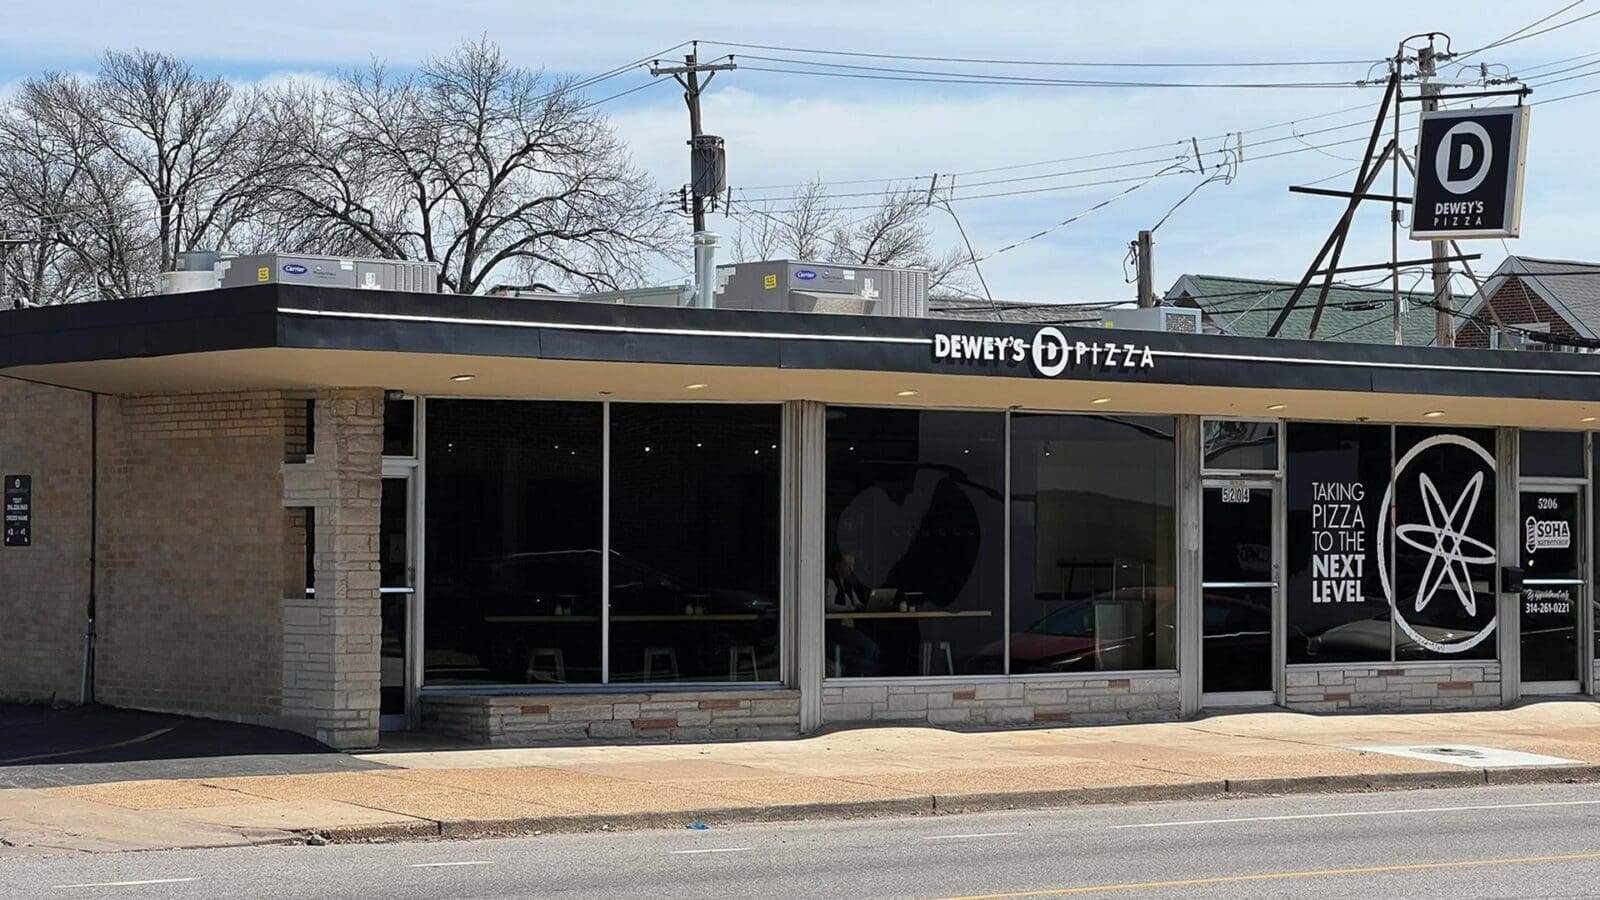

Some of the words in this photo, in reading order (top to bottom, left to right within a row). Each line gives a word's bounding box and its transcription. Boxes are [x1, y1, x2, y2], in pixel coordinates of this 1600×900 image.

[1446, 132, 1485, 182] D
[1435, 201, 1484, 215] DEWEY'S
[1433, 216, 1482, 226] PIZZA
[935, 334, 1025, 362] DEWEY'S
[1076, 341, 1154, 368] PIZZA
[1223, 487, 1249, 502] 5204
[1312, 482, 1365, 501] TAKING
[1538, 498, 1558, 509] 5206
[1312, 504, 1365, 528] PIZZA
[1537, 523, 1568, 537] SOHA
[1312, 531, 1334, 551] TO
[1338, 531, 1365, 551] THE
[1312, 554, 1365, 578] NEXT
[1312, 580, 1365, 603] LEVEL
[1525, 603, 1569, 613] 314-261-0221
